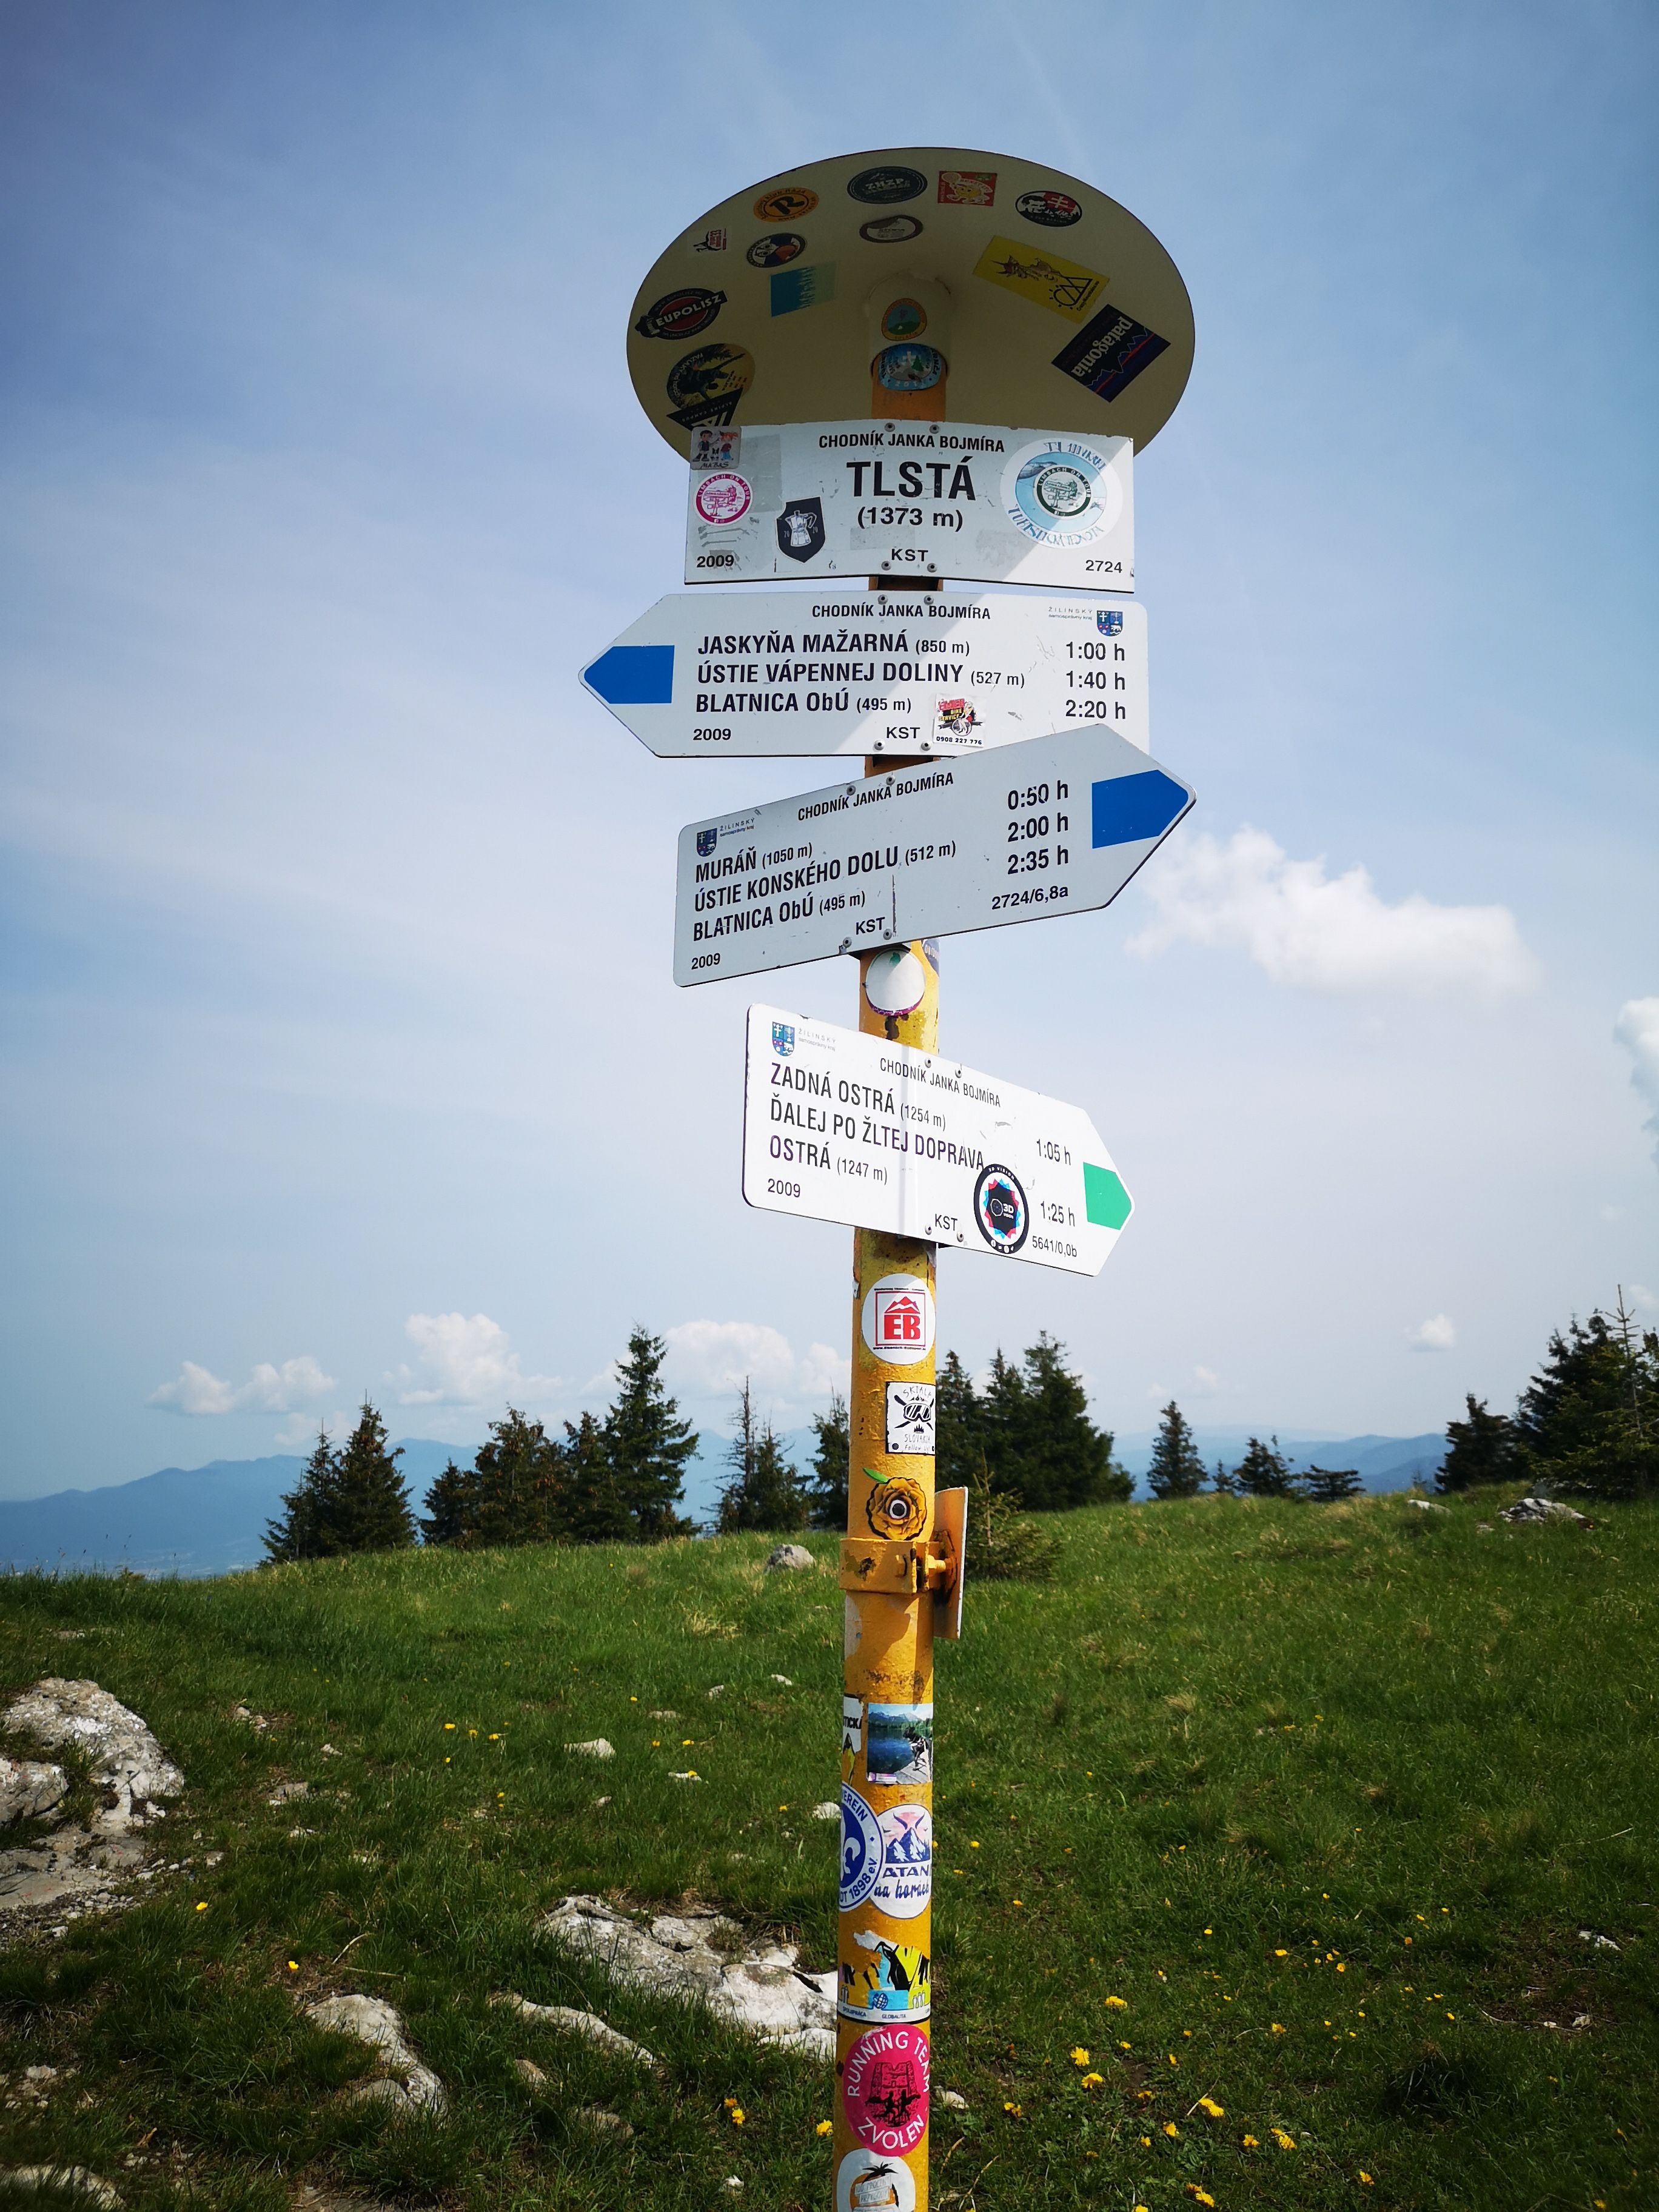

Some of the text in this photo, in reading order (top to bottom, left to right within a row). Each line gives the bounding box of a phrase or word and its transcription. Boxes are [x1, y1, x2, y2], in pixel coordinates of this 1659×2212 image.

[655, 293, 722, 327] EUPOLISZ
[1071, 315, 1133, 378] patagonia
[681, 401, 732, 423] ALPINE CAMPUS
[819, 430, 1005, 453] CHODNÍK JANKA BOJMÍRA
[697, 474, 750, 500] LIMBACH ON TOUR
[846, 455, 976, 501] TLSTÁ
[1038, 468, 1067, 486] LIMBACH
[1082, 479, 1091, 497] TOUR
[857, 507, 963, 532] (1373 m)
[697, 555, 734, 568] 2009
[892, 548, 928, 562] KST
[1085, 560, 1122, 574] 2724
[812, 602, 991, 620] CHODNÍK JANKA BOJMÍRA
[697, 629, 970, 657] JASKYŇA MAŽARNÁ (850 m)
[1066, 641, 1125, 661] 1:00 h
[697, 659, 1025, 689] ÚSTIE VÁPENNEJ DOLINY (527 m)
[1066, 671, 1125, 690] 1:40 h
[696, 687, 911, 714] BLATNICA ObÚ (495 m)
[1065, 699, 1126, 719] 2:20 h
[693, 728, 732, 741] 2009
[886, 726, 920, 739] KST
[798, 772, 954, 821] CHODNÍK JANKA BOJMÍRA
[1008, 780, 1068, 810] 0:50 h
[1008, 812, 1068, 842] 2:00 h
[695, 842, 813, 883] MURÁŇ (1050 m)
[1007, 845, 1068, 875] 2:35 h
[695, 840, 956, 912] ÚSTIE KONSKÉHO DOLU (512 m)
[991, 885, 1068, 910] 2724/6,8a
[693, 891, 865, 942] BLATNICA ObÚ (495 m)
[856, 917, 885, 936] KST
[691, 953, 720, 970] 2009
[880, 1057, 1000, 1108] CHODNÍK JANKA BOJMÍRA
[771, 1062, 946, 1131] ZADNÁ OSTRÁ (1254 m)
[771, 1093, 984, 1170] ĎALEJ PO ŽLTEJ DOPRAVA
[770, 1135, 888, 1185] OSTRÁ (1247 m)
[1036, 1138, 1071, 1165] 1:05 h
[996, 1166, 1014, 1180] VISION
[768, 1178, 801, 1198] 2009
[1003, 1203, 1014, 1214] 3D
[1041, 1201, 1075, 1227] 1:25 h
[934, 1213, 958, 1232] KST
[1032, 1235, 1078, 1258] 5641/0,0b
[884, 1315, 920, 1340] EB
[904, 1433, 930, 1444] SLOVAKIA
[849, 1872, 871, 1899] 1898
[868, 1857, 879, 1874] e.V.
[882, 1865, 931, 1879] ATAN
[874, 1885, 890, 1898] na
[848, 2031, 930, 2097] RUNNING TEAM
[857, 2114, 925, 2150] ZVOLEN
